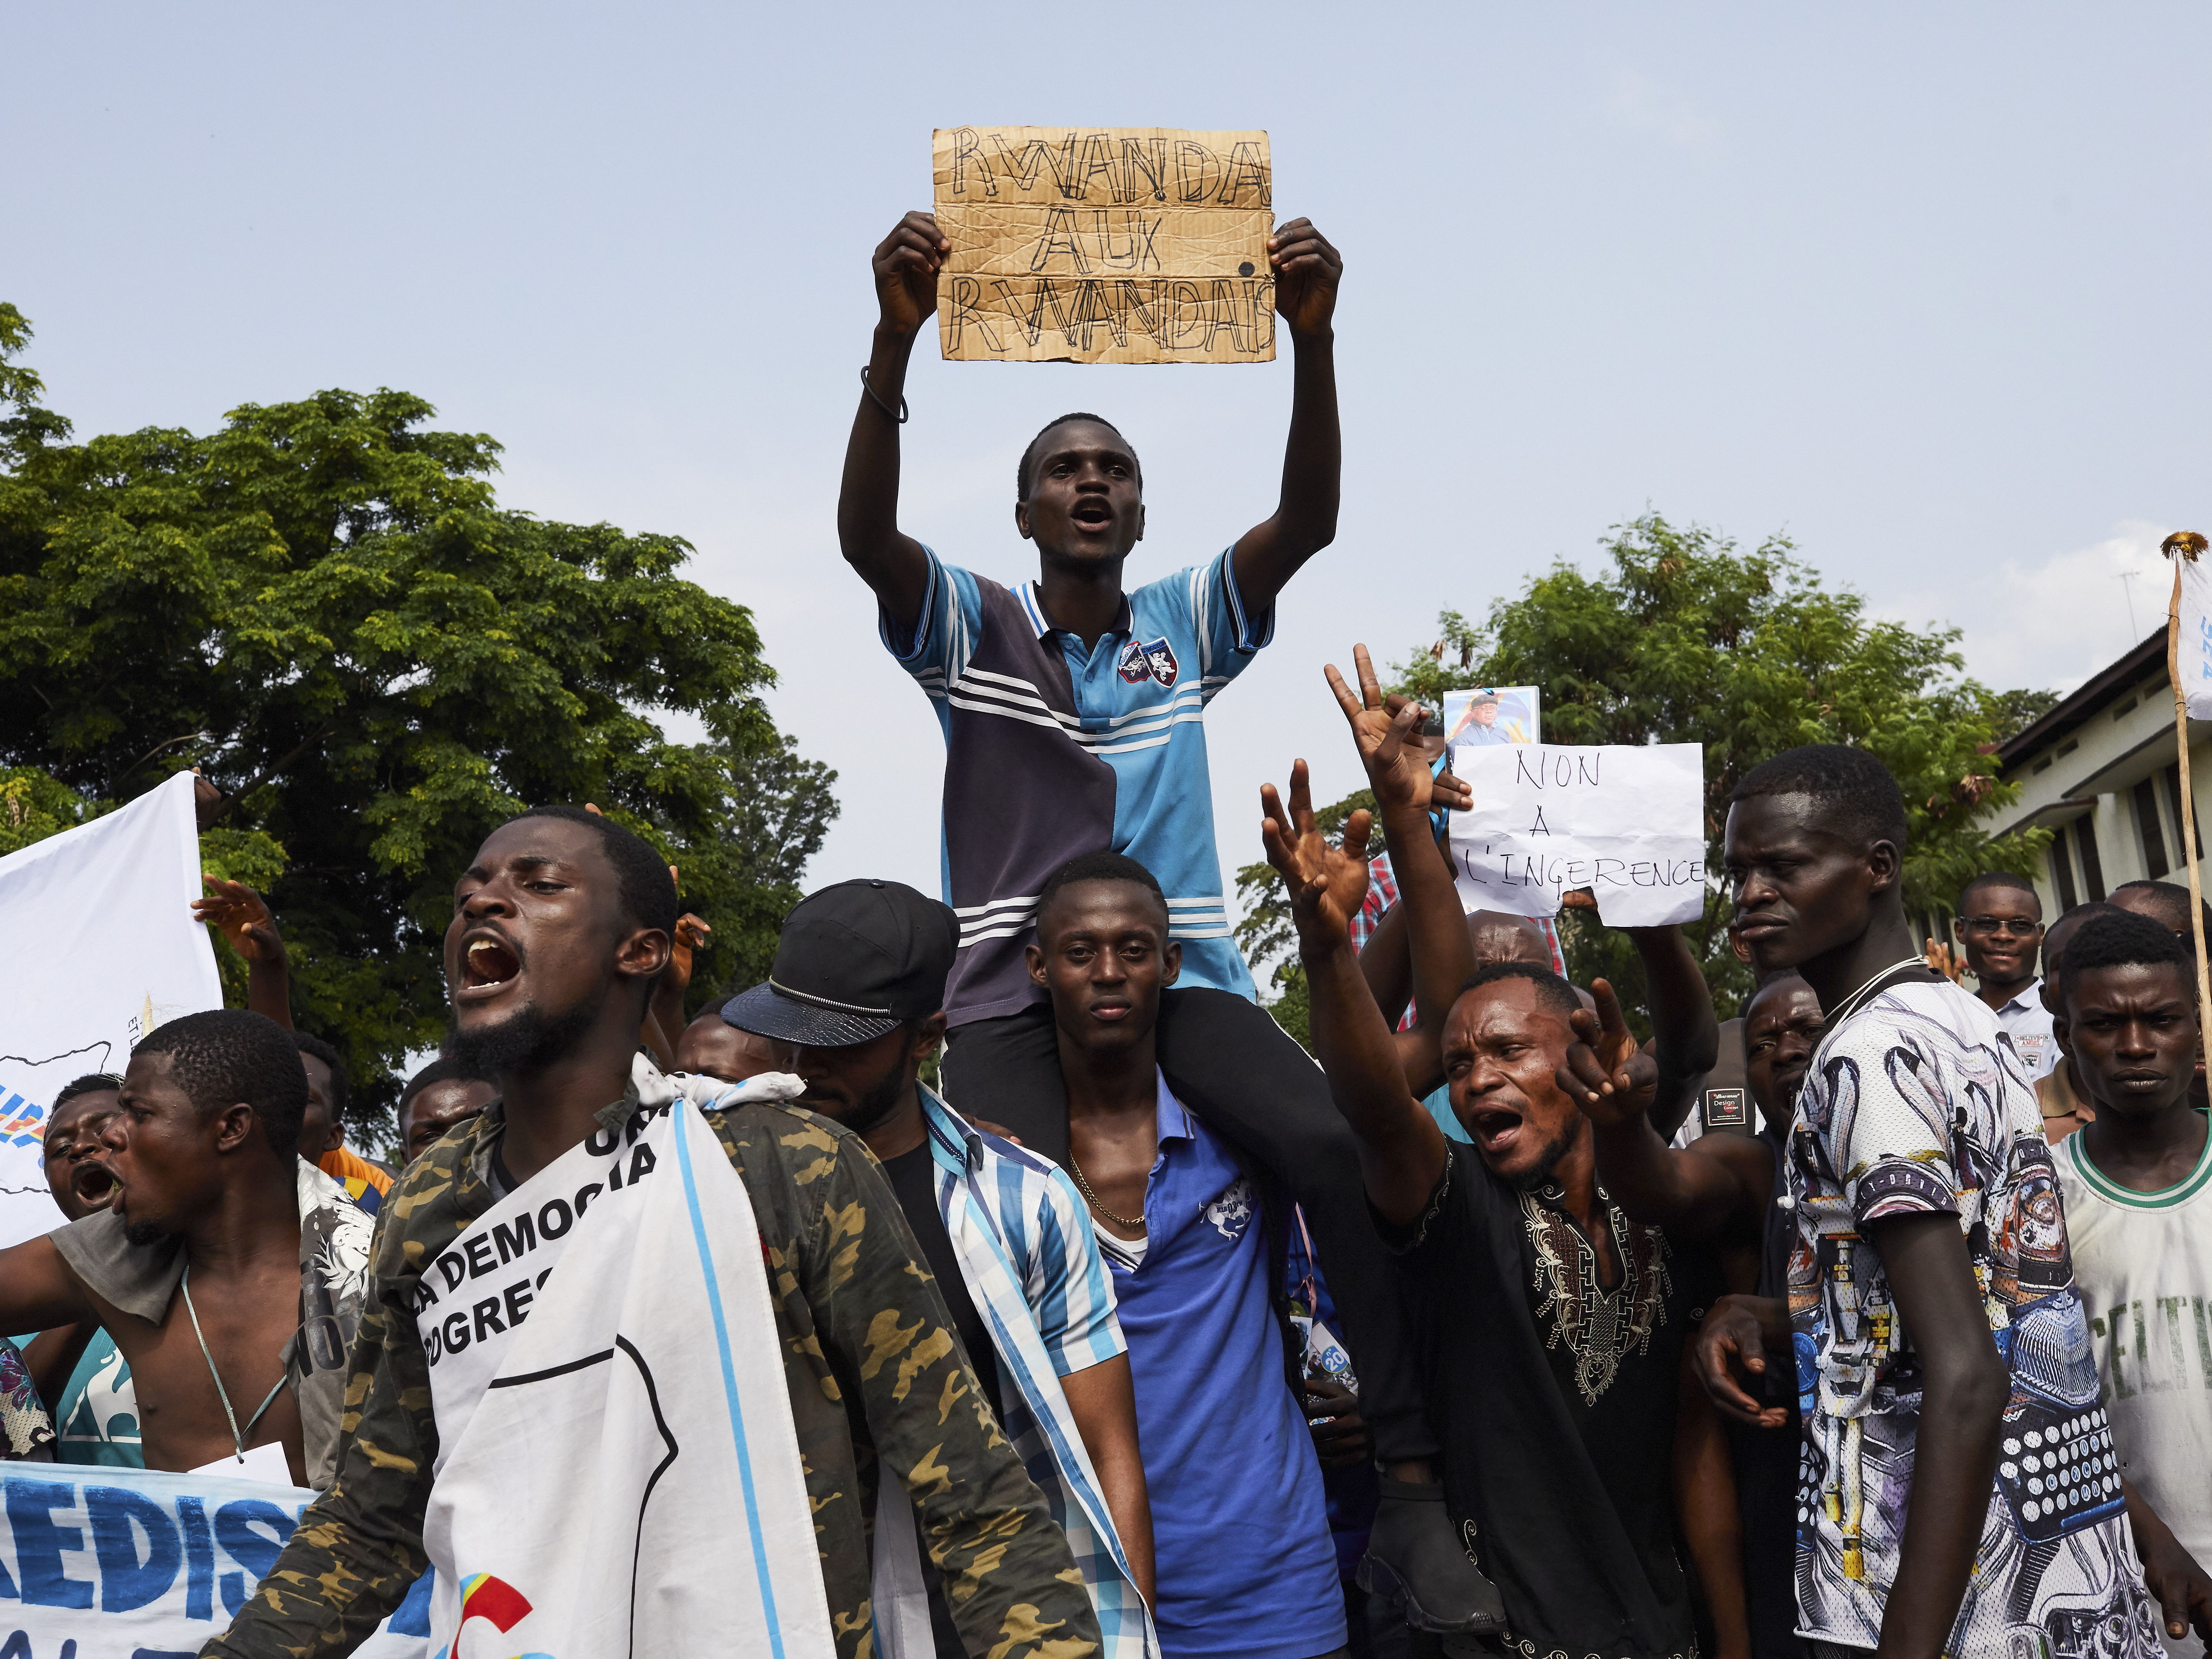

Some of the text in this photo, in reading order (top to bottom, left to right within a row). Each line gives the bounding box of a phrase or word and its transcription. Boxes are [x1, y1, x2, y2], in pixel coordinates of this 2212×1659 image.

[952, 128, 1271, 204] RWANDA
[1030, 208, 1162, 274] AUX
[948, 276, 1276, 354] RWANDAIS
[1516, 749, 1600, 789] NON
[1529, 804, 1550, 837] A
[1465, 845, 1704, 901] L'INGERENCE
[1325, 1351, 1345, 1372] 20
[0, 1475, 313, 1622] EDIS
